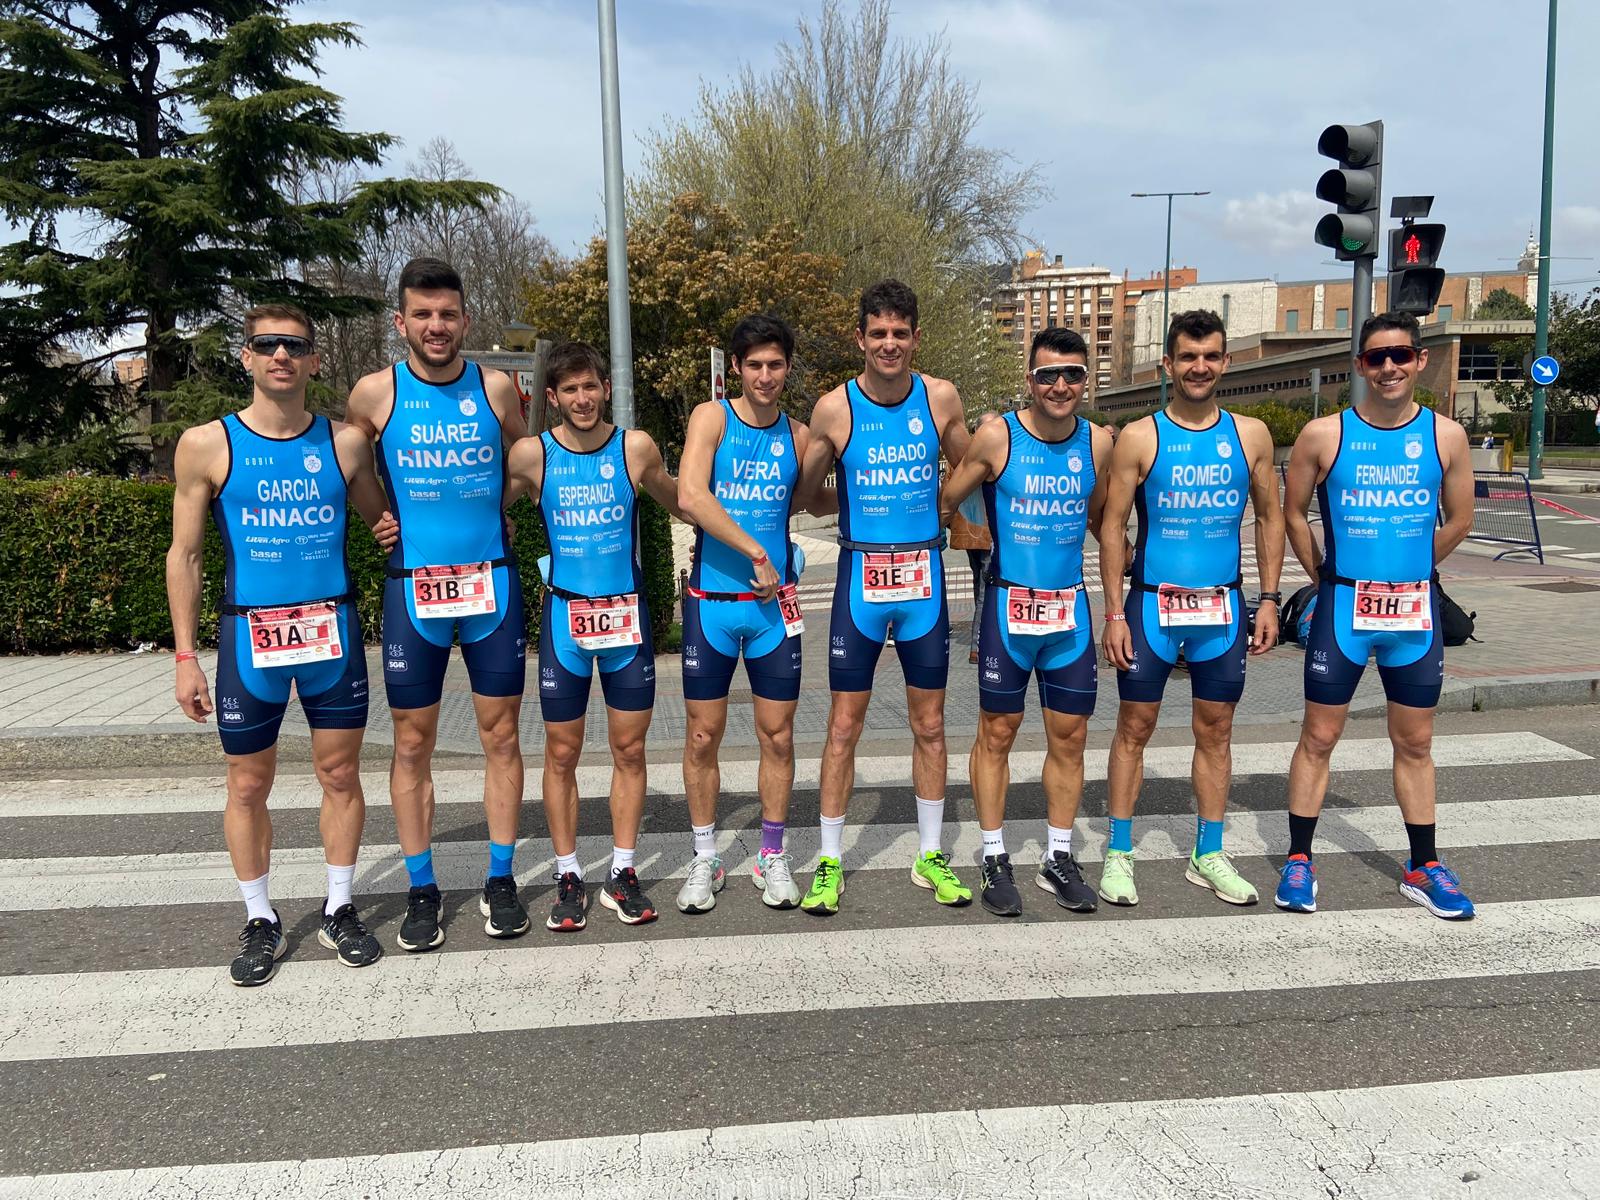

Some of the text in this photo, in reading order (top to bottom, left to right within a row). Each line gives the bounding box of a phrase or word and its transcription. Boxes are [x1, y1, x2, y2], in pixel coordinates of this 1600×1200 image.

[410, 420, 481, 444] SUÁREZ
[868, 442, 926, 464] SÁBADO
[732, 458, 781, 480] VERA
[1172, 464, 1232, 486] ROMEO
[1356, 464, 1419, 485] FERNANDEZ
[258, 478, 320, 502] GARCIA
[558, 482, 616, 506] ESPERANZA
[1024, 474, 1080, 494] MIRON
[868, 568, 902, 586] 31E
[420, 580, 460, 602] 31B
[1014, 602, 1046, 621] 31F
[1164, 594, 1198, 610] 31G
[1360, 597, 1399, 614] 31H
[575, 614, 610, 634] 31C
[257, 624, 304, 648] 31A
[986, 671, 999, 680] SGR
[1312, 664, 1326, 672] SGR
